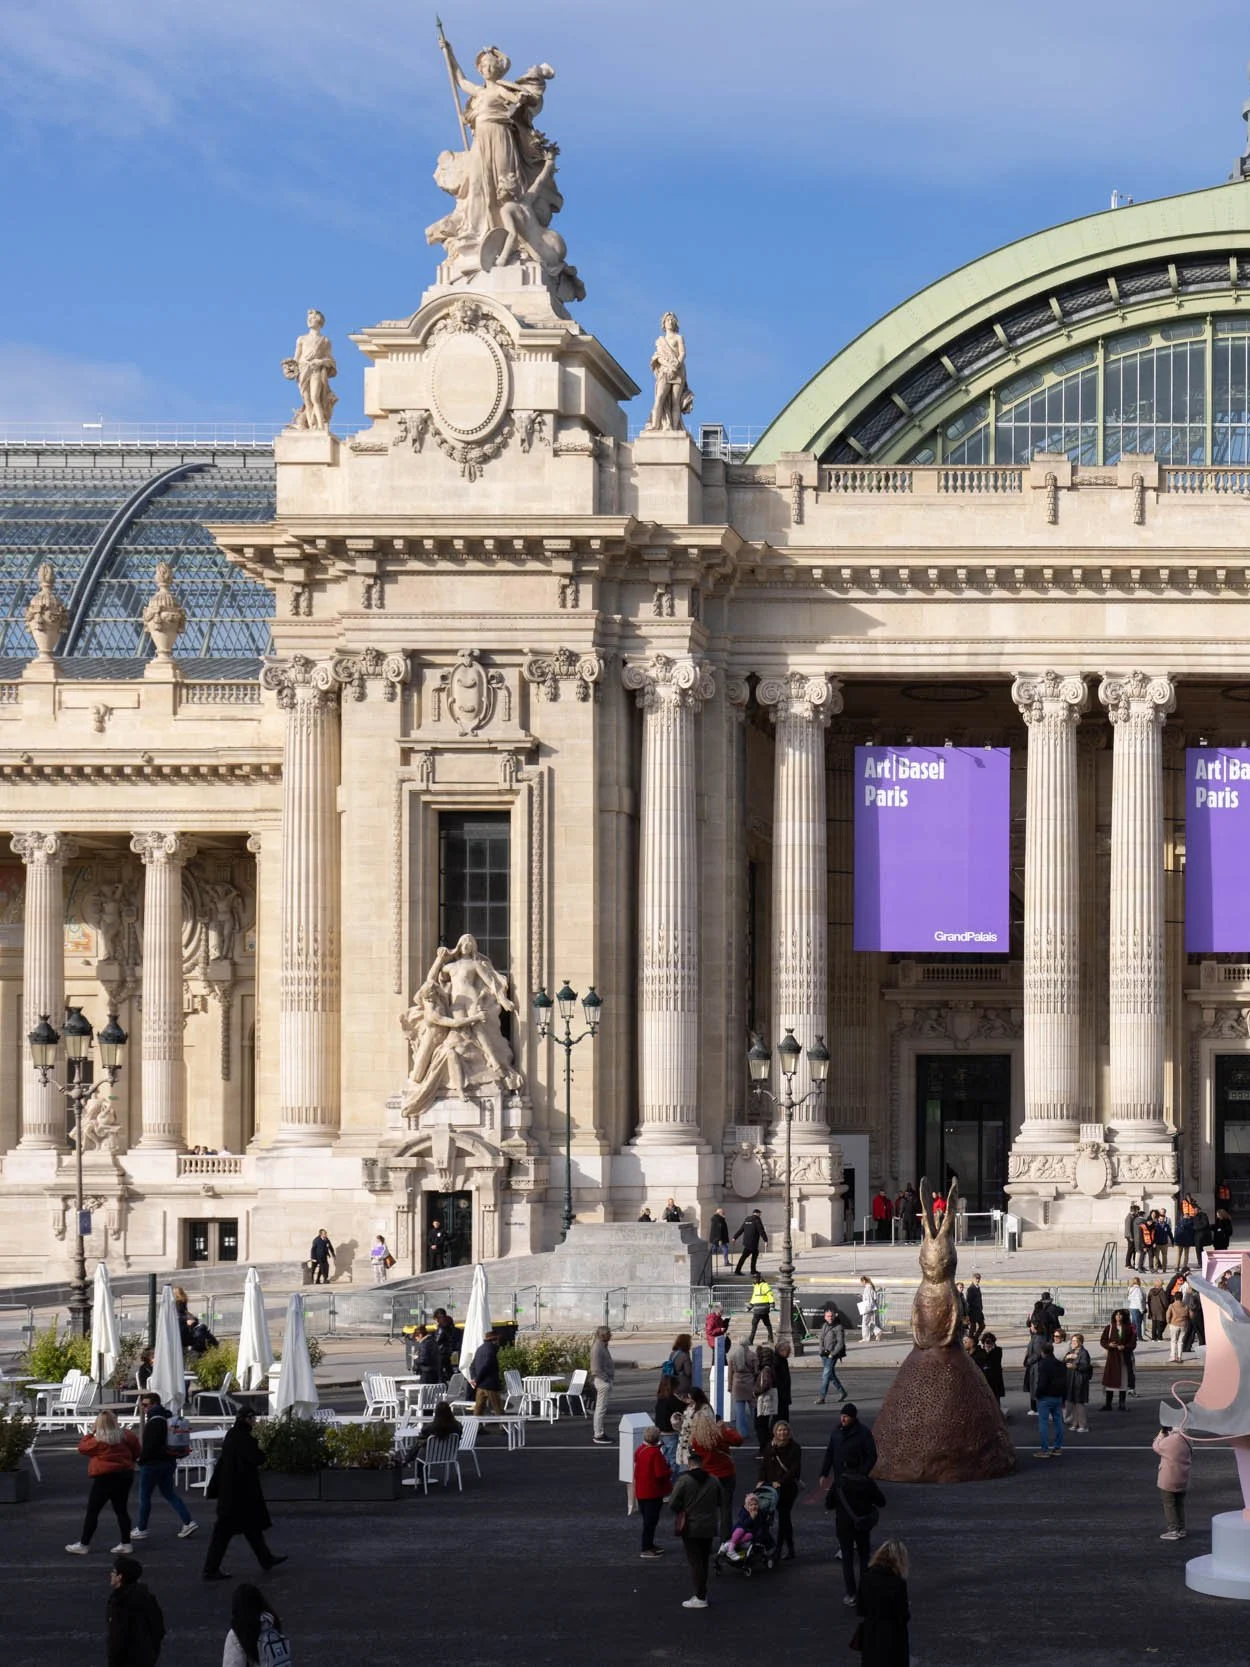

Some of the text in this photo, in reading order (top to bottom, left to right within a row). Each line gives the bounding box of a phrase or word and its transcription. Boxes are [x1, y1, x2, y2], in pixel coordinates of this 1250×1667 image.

[864, 756, 945, 780] Art Basel
[1195, 758, 1222, 780] Art
[864, 785, 908, 807] Paris
[1195, 787, 1239, 808] Paris
[934, 930, 998, 942] GrandPalais
